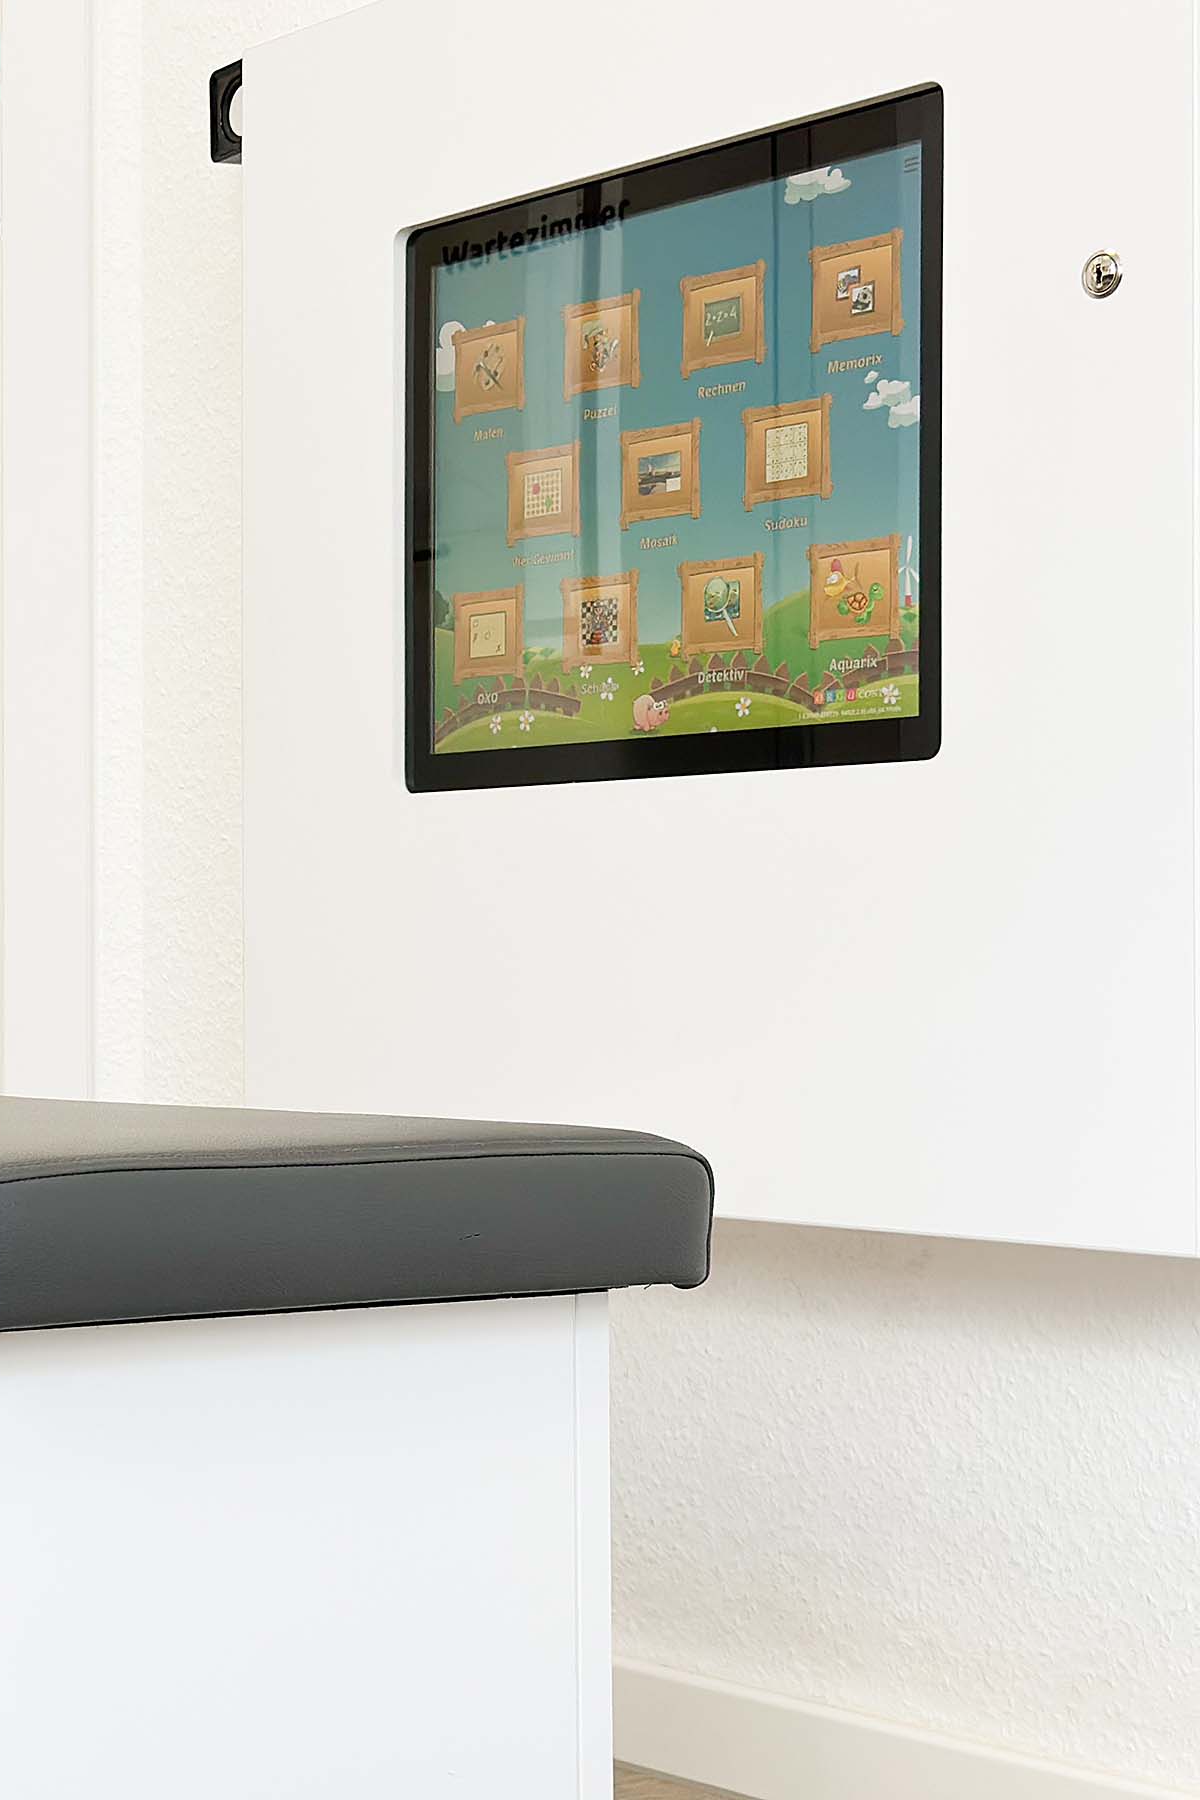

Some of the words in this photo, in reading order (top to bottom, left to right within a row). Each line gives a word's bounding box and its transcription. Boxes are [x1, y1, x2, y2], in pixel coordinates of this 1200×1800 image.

[826, 353, 885, 375] Memorix
[697, 380, 748, 400] Rechnen
[828, 654, 879, 674] Aquarix
[697, 668, 745, 685] Detektiv
